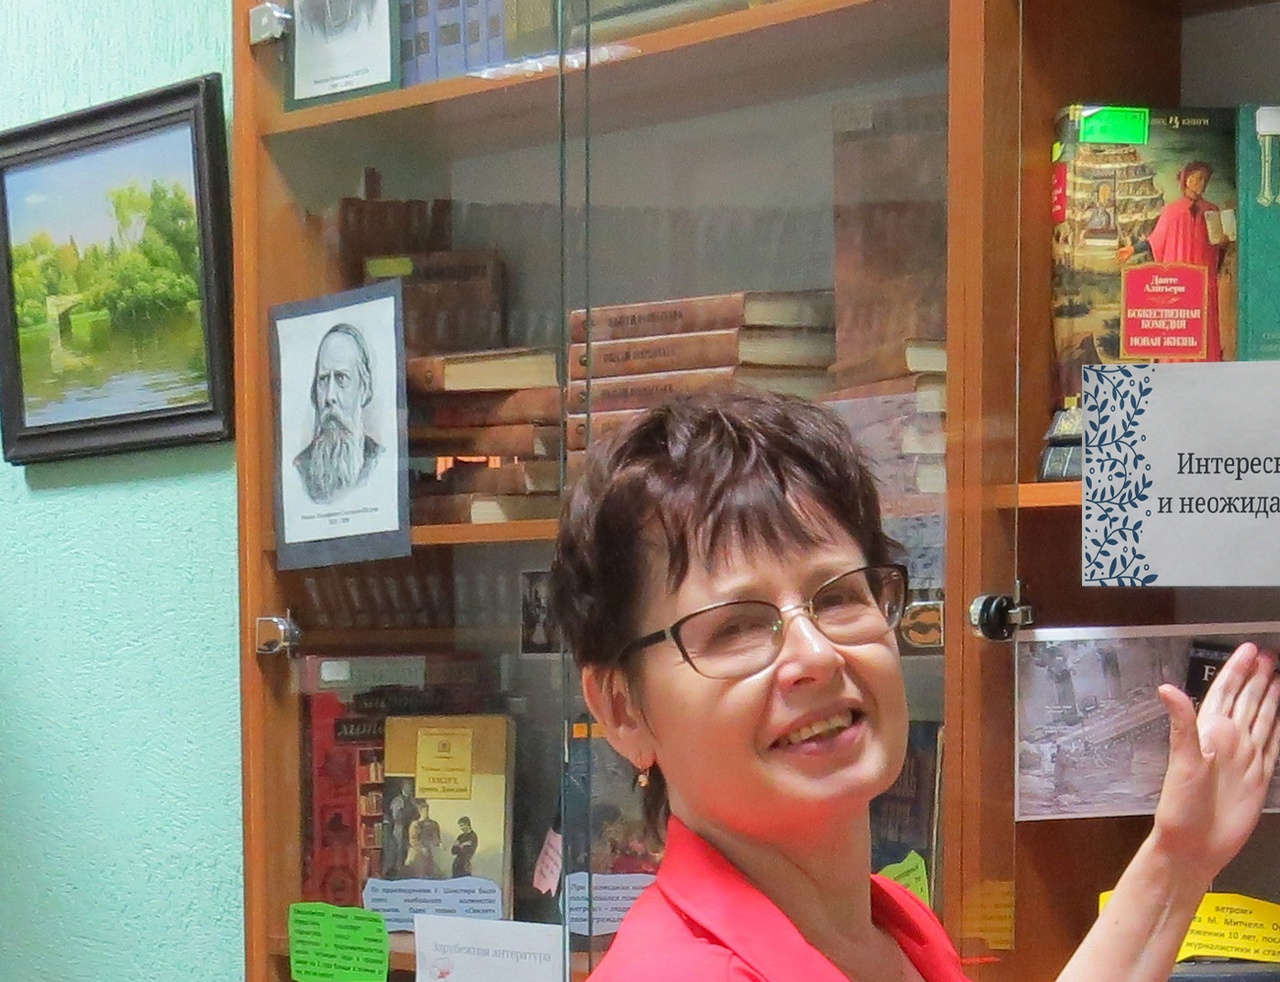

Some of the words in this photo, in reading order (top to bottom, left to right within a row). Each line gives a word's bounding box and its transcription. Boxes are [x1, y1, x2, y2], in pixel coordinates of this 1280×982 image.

[1127, 308, 1201, 319] БОЖЕСТВЕННАЯ
[1141, 320, 1186, 330] КОМЕДИЯ
[1157, 497, 1173, 513] и
